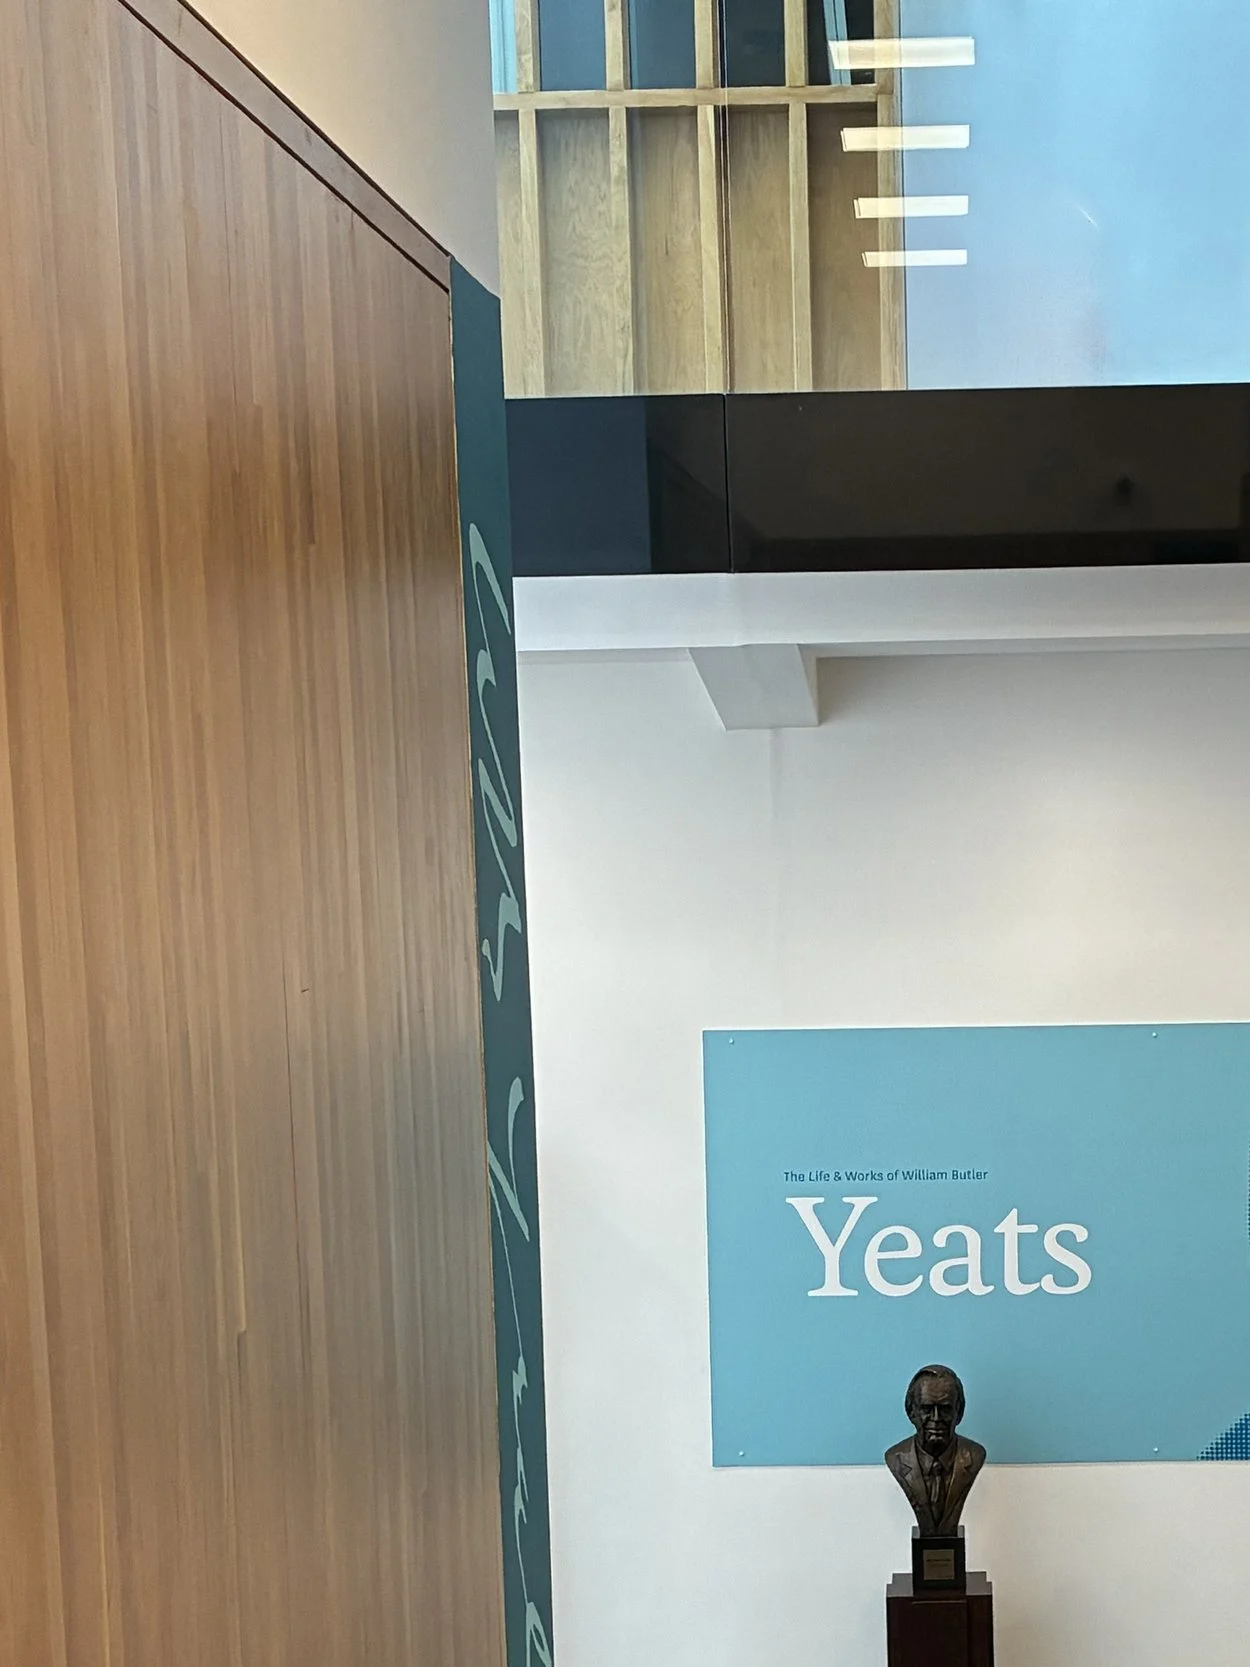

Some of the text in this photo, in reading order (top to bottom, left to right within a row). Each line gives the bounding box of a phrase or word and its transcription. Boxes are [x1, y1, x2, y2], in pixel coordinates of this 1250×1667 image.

[784, 1168, 988, 1182] The Life & Works of William Butler
[785, 1196, 1092, 1297] Yeats
